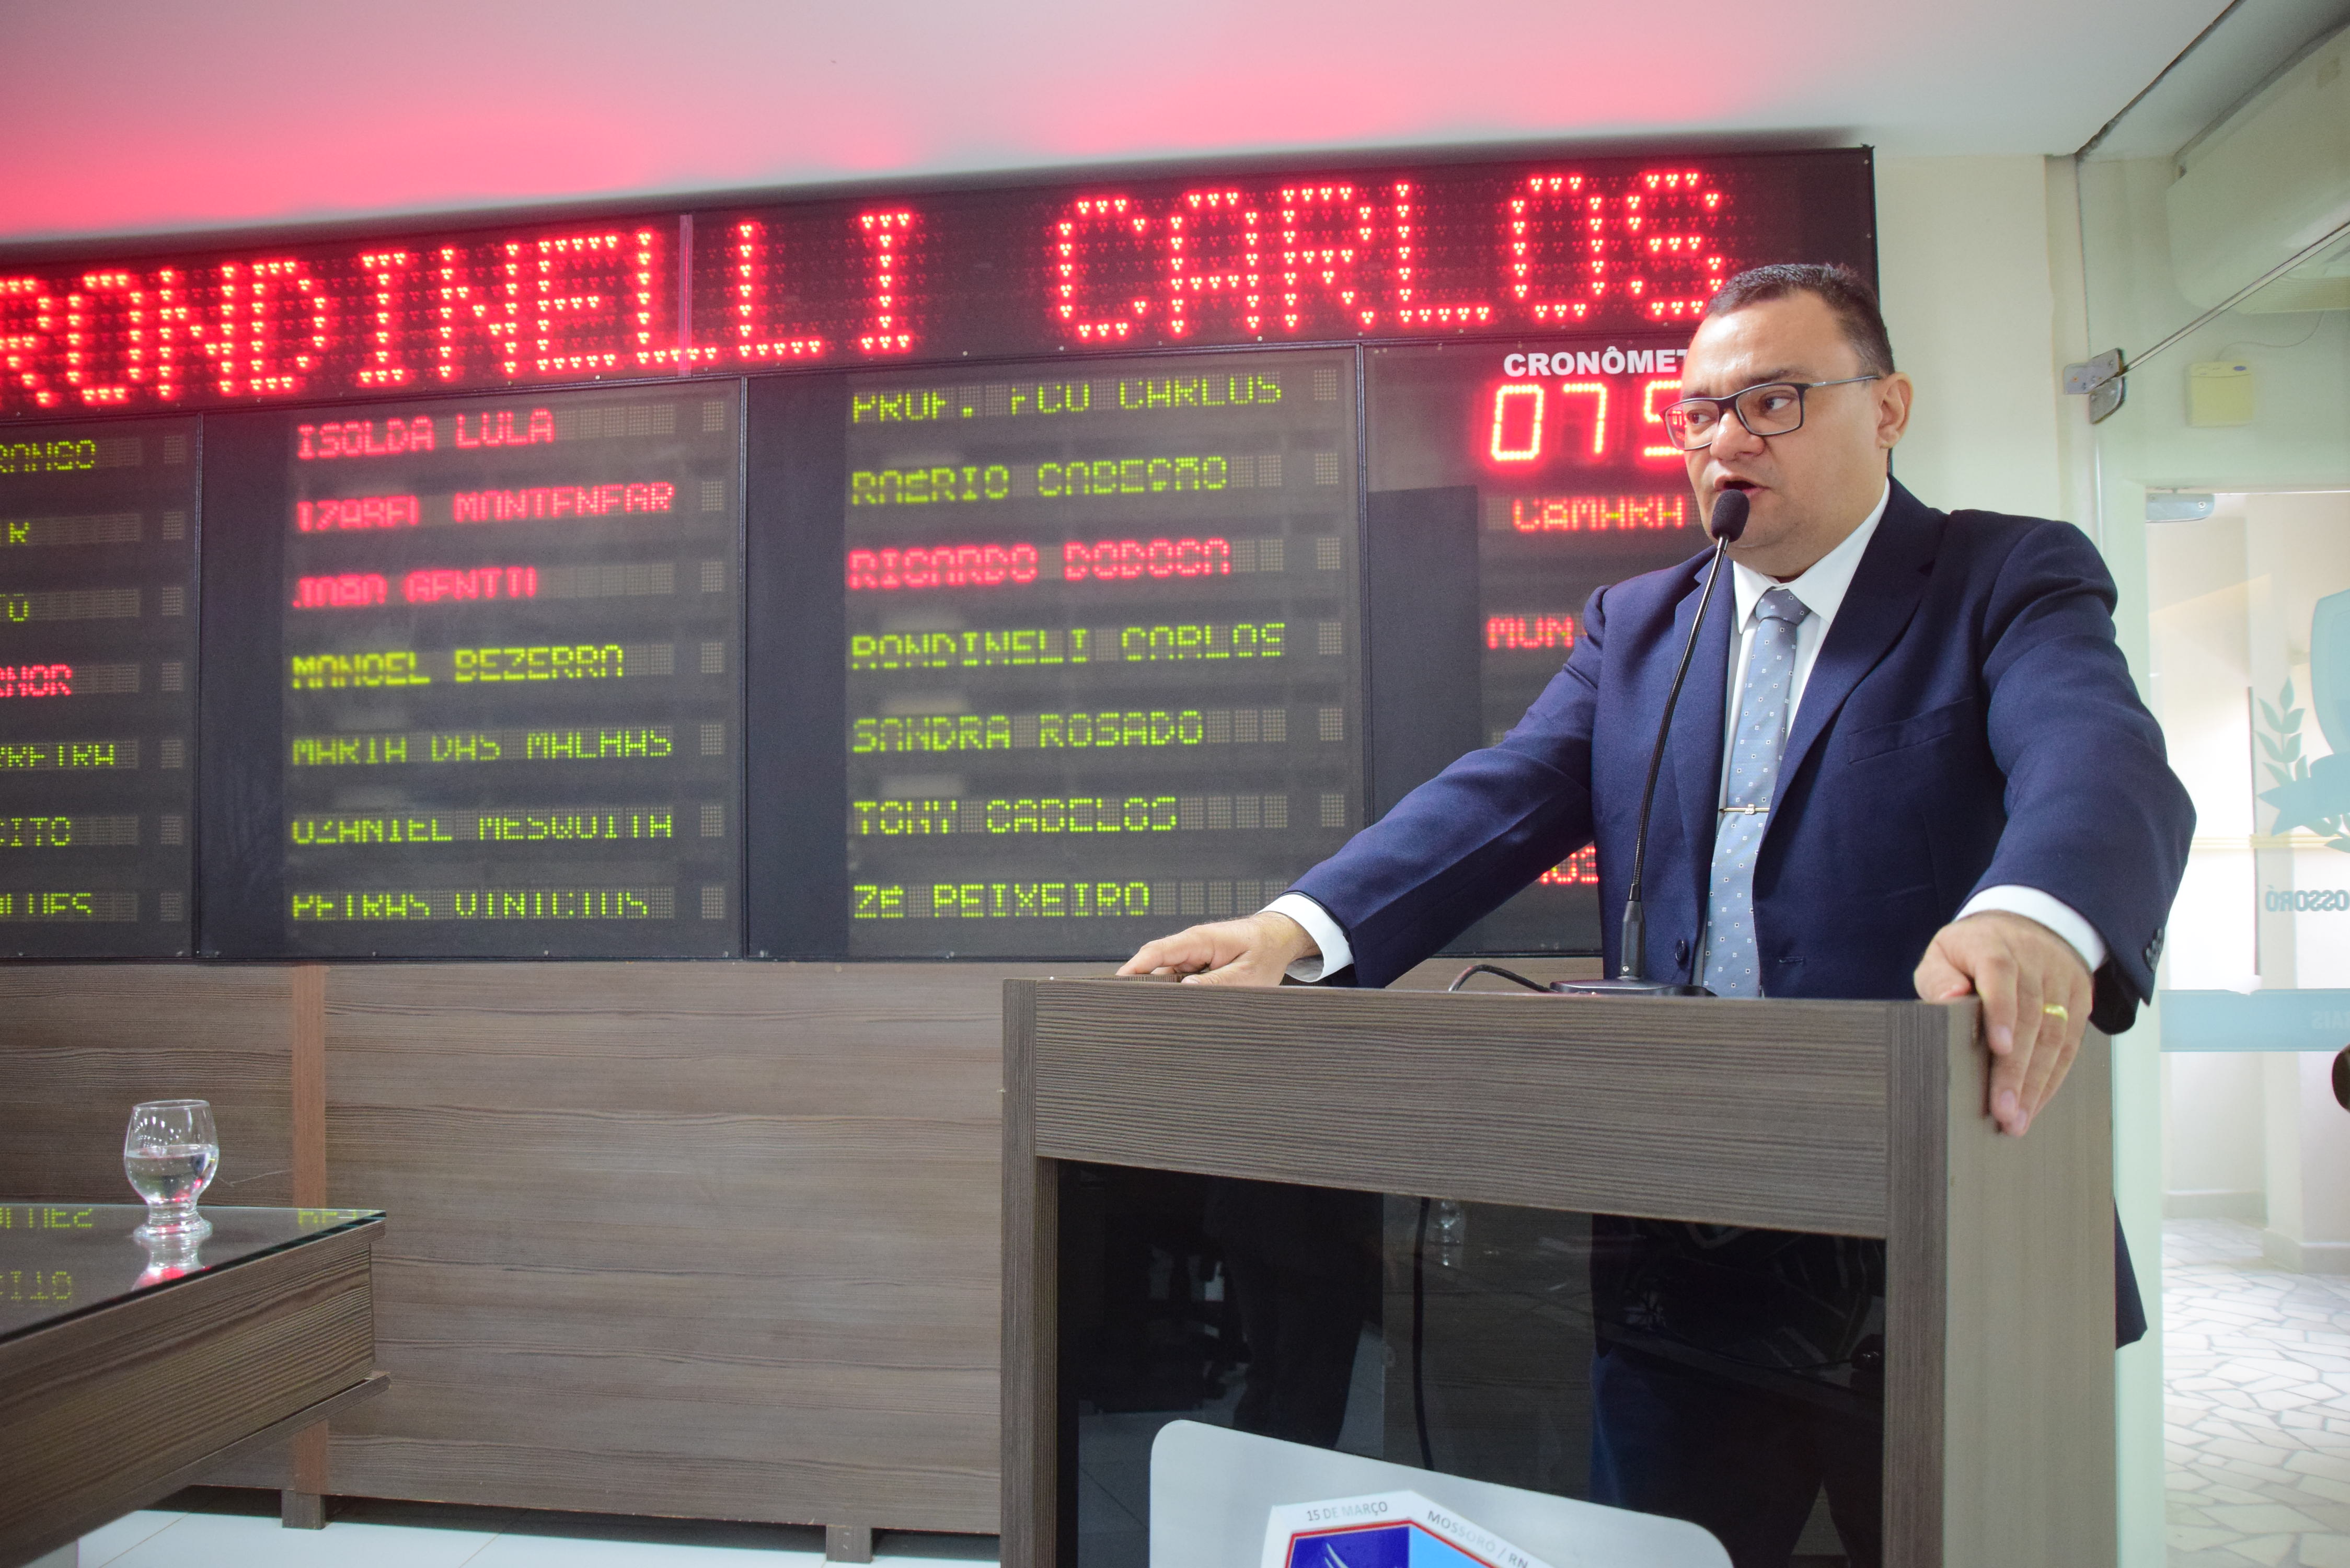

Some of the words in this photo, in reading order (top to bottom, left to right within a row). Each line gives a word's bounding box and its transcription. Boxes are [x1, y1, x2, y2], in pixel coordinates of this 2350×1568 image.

[0, 212, 911, 406] RONDINELLI
[1060, 172, 1724, 338] CARLOS
[297, 415, 435, 460] ISOLDA
[454, 408, 555, 449] LULA
[847, 544, 1039, 590] RICARDO
[853, 716, 1010, 753] SANDRA
[1040, 711, 1203, 747] ROSADO
[1307, 1509, 1320, 1521] 15
[1323, 1508, 1339, 1519] DE
[1342, 1501, 1388, 1518] MARÇO
[1427, 1510, 1496, 1553] MOSSORÓ
[1508, 1552, 1529, 1568] RN
